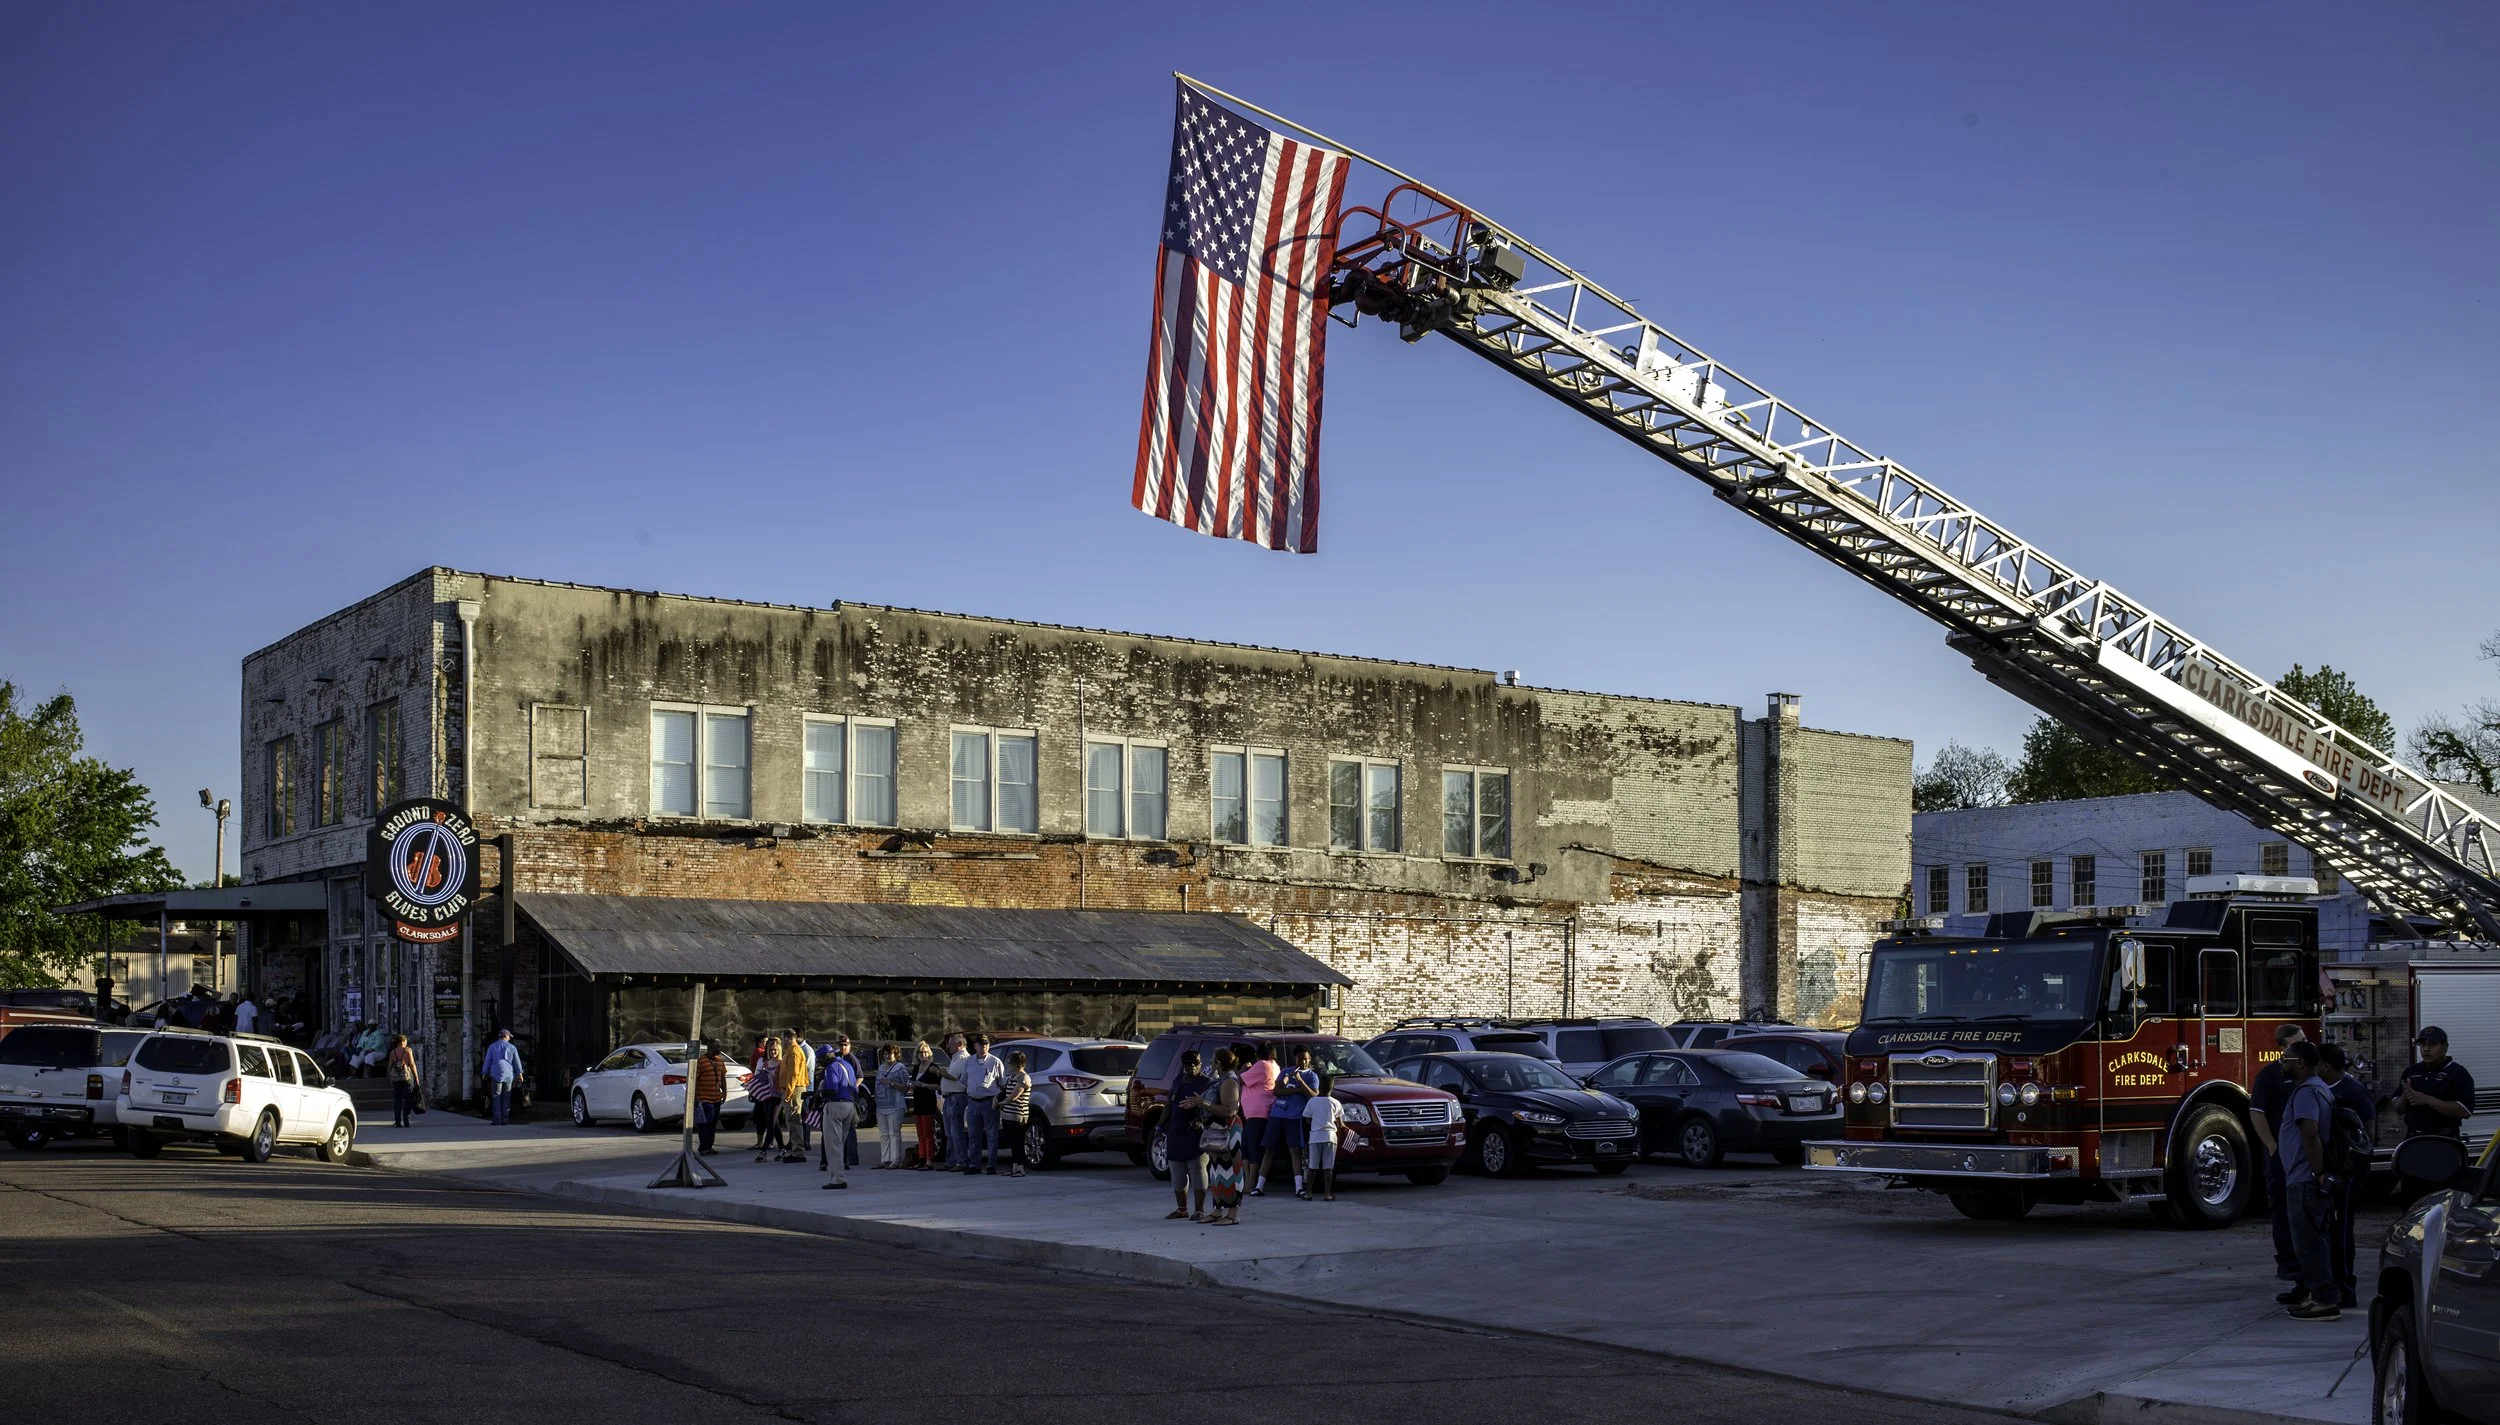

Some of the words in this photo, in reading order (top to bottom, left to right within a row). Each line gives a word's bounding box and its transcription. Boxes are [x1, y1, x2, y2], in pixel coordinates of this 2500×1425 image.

[2185, 663, 2307, 753] CLARKSDALE
[2312, 738, 2354, 782] FIRE
[2358, 766, 2405, 814] DEPT.
[380, 806, 430, 841] GROUND
[445, 813, 476, 846] ZERO
[385, 890, 428, 922] BLUES
[434, 893, 468, 921] CLUB
[399, 926, 459, 940] CLARKSDALE
[1878, 1031, 1948, 1044] CLARKSDALE
[1952, 1031, 1982, 1041] FIRE
[1986, 1032, 2022, 1043] DEPT.
[2108, 1051, 2170, 1073] CLARKSDALE
[2115, 1075, 2136, 1086] FIRE
[2140, 1074, 2166, 1086] DEPT.
